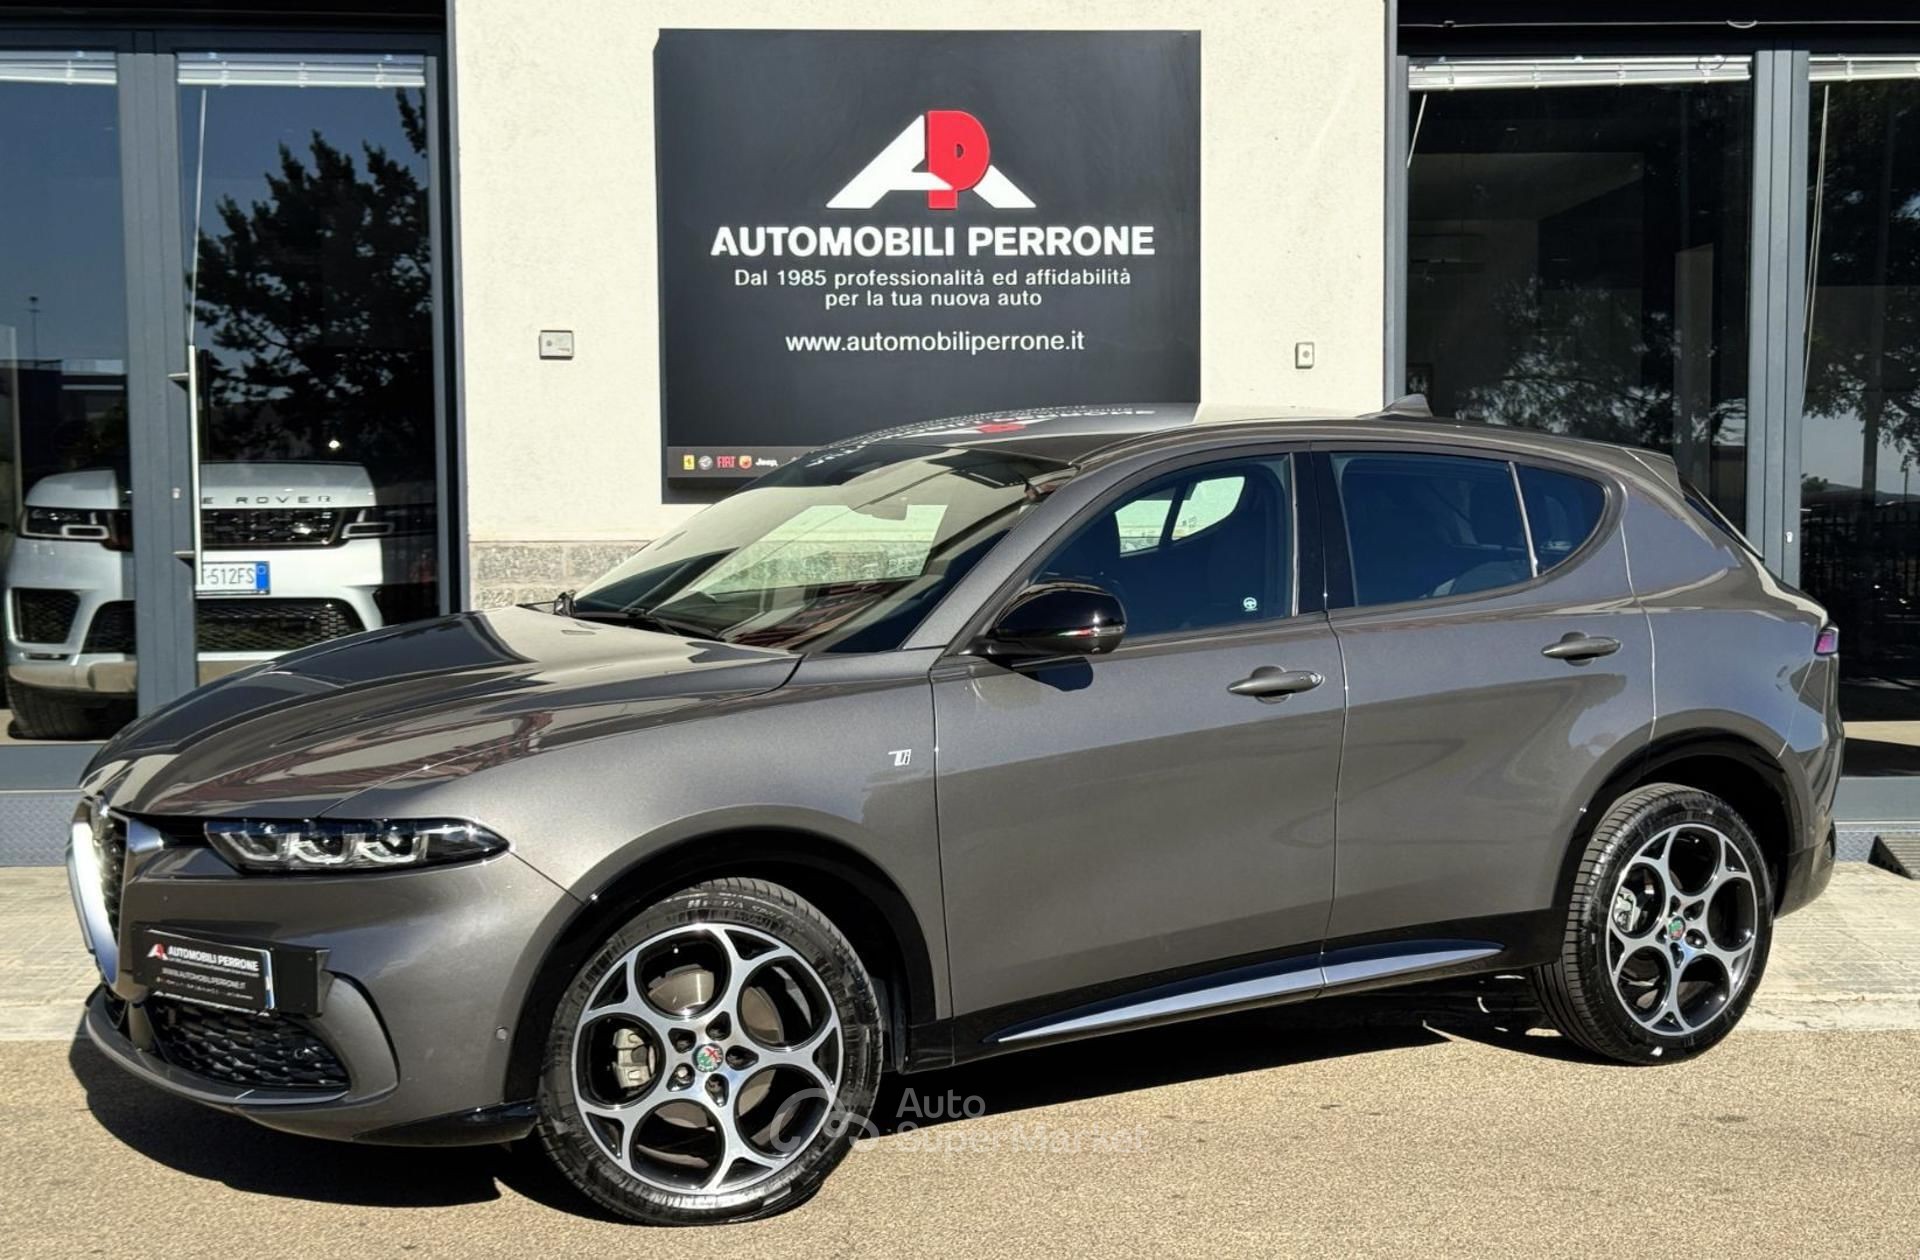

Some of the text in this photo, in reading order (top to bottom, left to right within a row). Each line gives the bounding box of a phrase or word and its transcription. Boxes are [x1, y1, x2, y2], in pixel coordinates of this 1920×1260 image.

[710, 225, 1156, 258] AUTOMOBILI PERRONE
[734, 267, 1132, 290] Dal 1985 professionalità ed affidabilità
[825, 290, 1043, 310] per la tua nuova auto
[785, 330, 1085, 356] www.automobiliperrone.it
[717, 456, 778, 469] FIAT Jeep
[236, 495, 333, 505] ROVER
[167, 945, 217, 964] AUTOMOBILI
[217, 955, 259, 972] PERRONE
